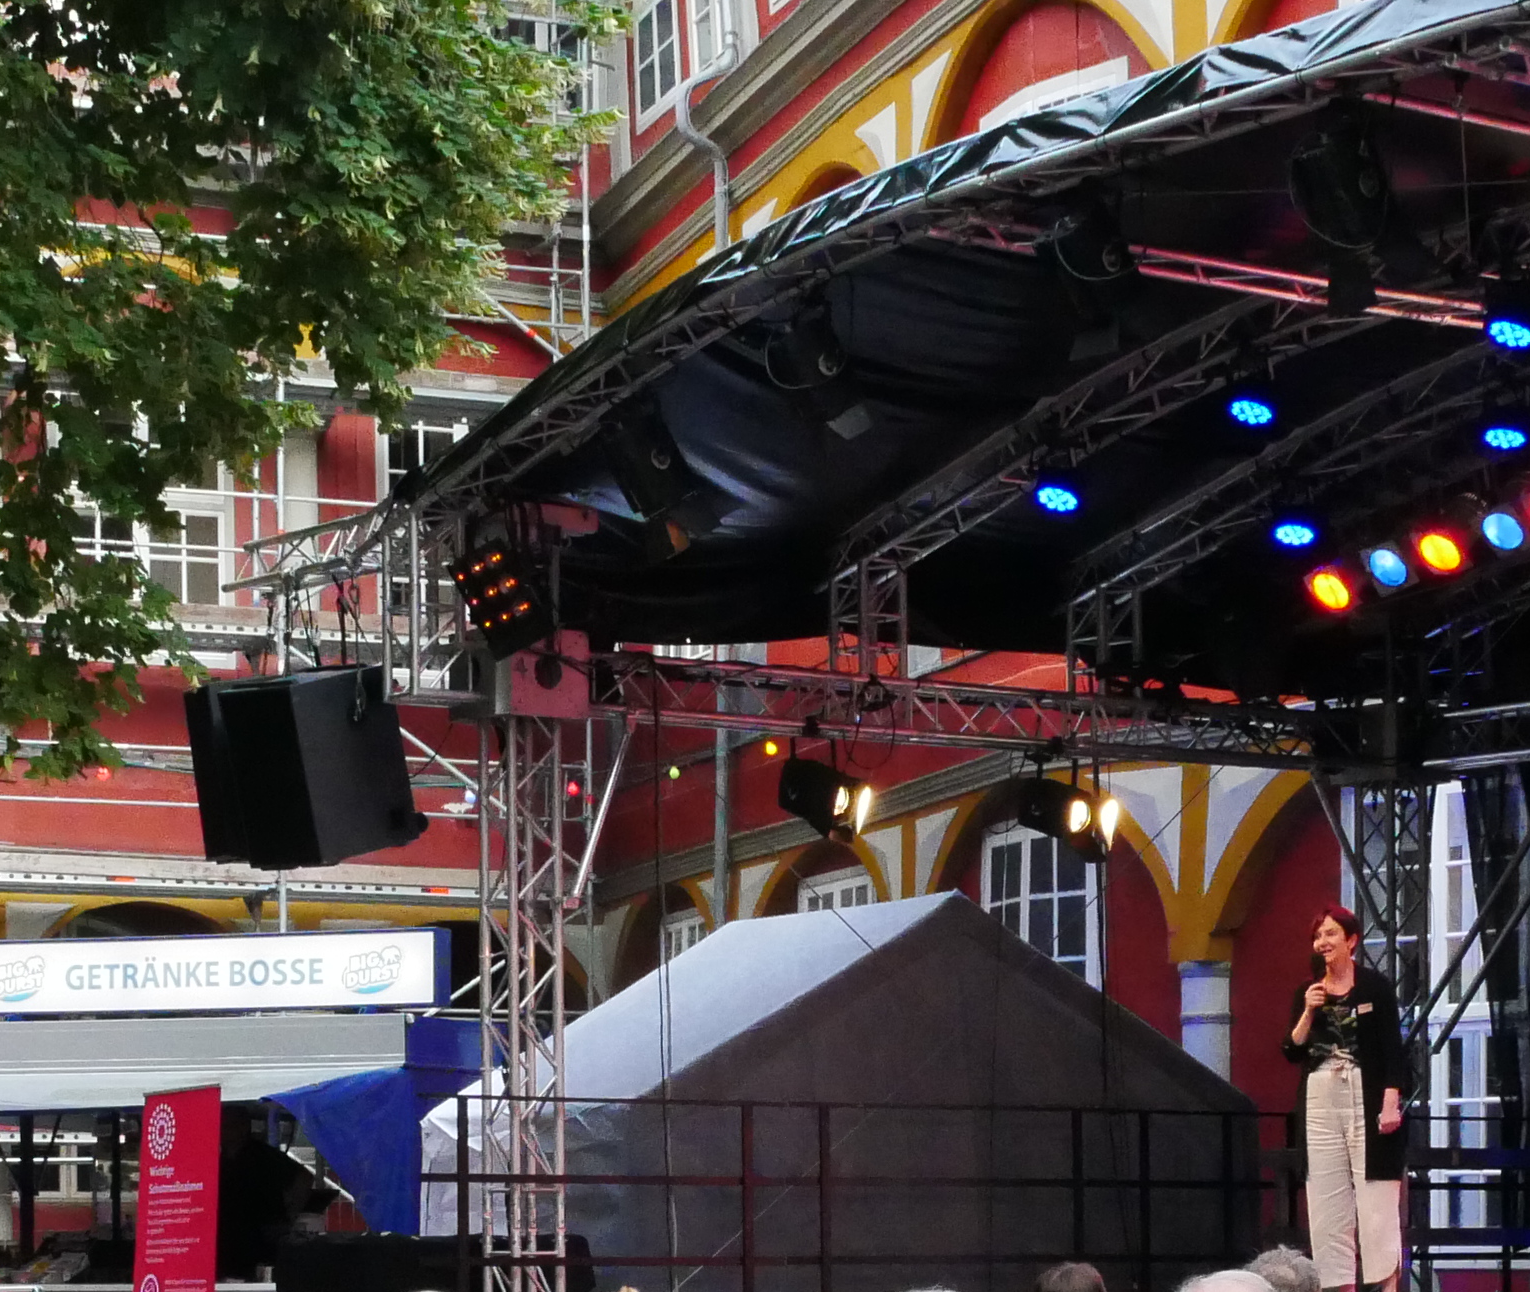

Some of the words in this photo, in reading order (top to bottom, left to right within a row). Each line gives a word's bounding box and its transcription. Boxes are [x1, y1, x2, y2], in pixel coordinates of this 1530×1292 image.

[65, 956, 220, 992] GETRÄNKE
[229, 958, 324, 988] BOSSE
[345, 961, 401, 988] DURST
[349, 951, 381, 972] BIG
